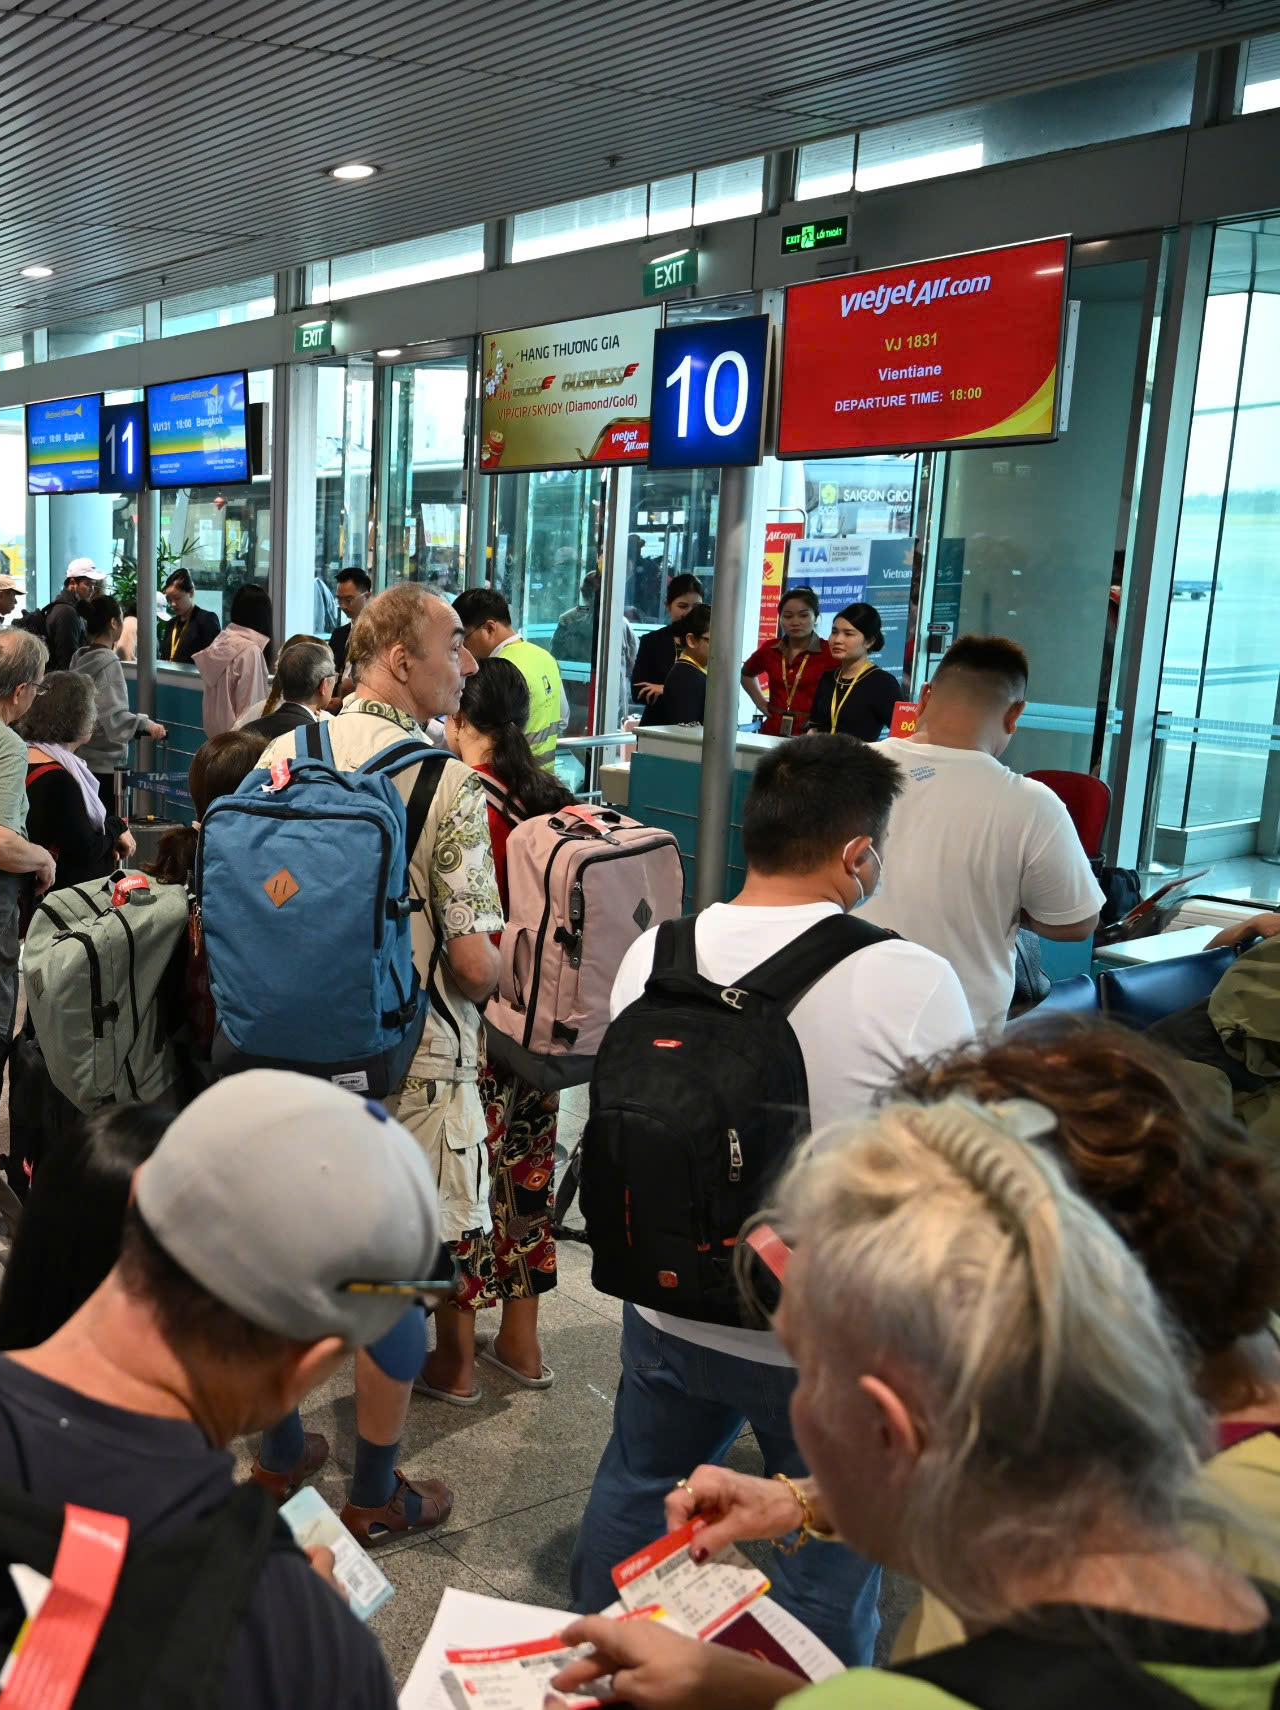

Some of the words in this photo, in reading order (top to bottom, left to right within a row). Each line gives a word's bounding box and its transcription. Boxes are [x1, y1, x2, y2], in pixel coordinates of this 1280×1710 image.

[786, 235, 801, 245] EXIT
[654, 260, 685, 289] EXIT
[302, 328, 323, 348] EXIT
[884, 337, 902, 352] VJ
[907, 332, 937, 349] 1831
[520, 346, 550, 365] HẠNG
[553, 338, 598, 357] THƯƠNG
[601, 335, 620, 350] GIA
[878, 363, 942, 382] Vientiane
[666, 350, 749, 438] 10
[834, 394, 906, 412] DEPARTURE
[910, 391, 943, 406] TIME:
[949, 387, 982, 402] 18:00
[565, 394, 638, 415] (Diamond/Gold)
[152, 421, 171, 432] VU131
[176, 419, 192, 429] 18:00
[196, 415, 224, 427] Bangkok
[105, 421, 133, 474] 11
[843, 489, 885, 502] SAIGON
[798, 546, 828, 563] TIA
